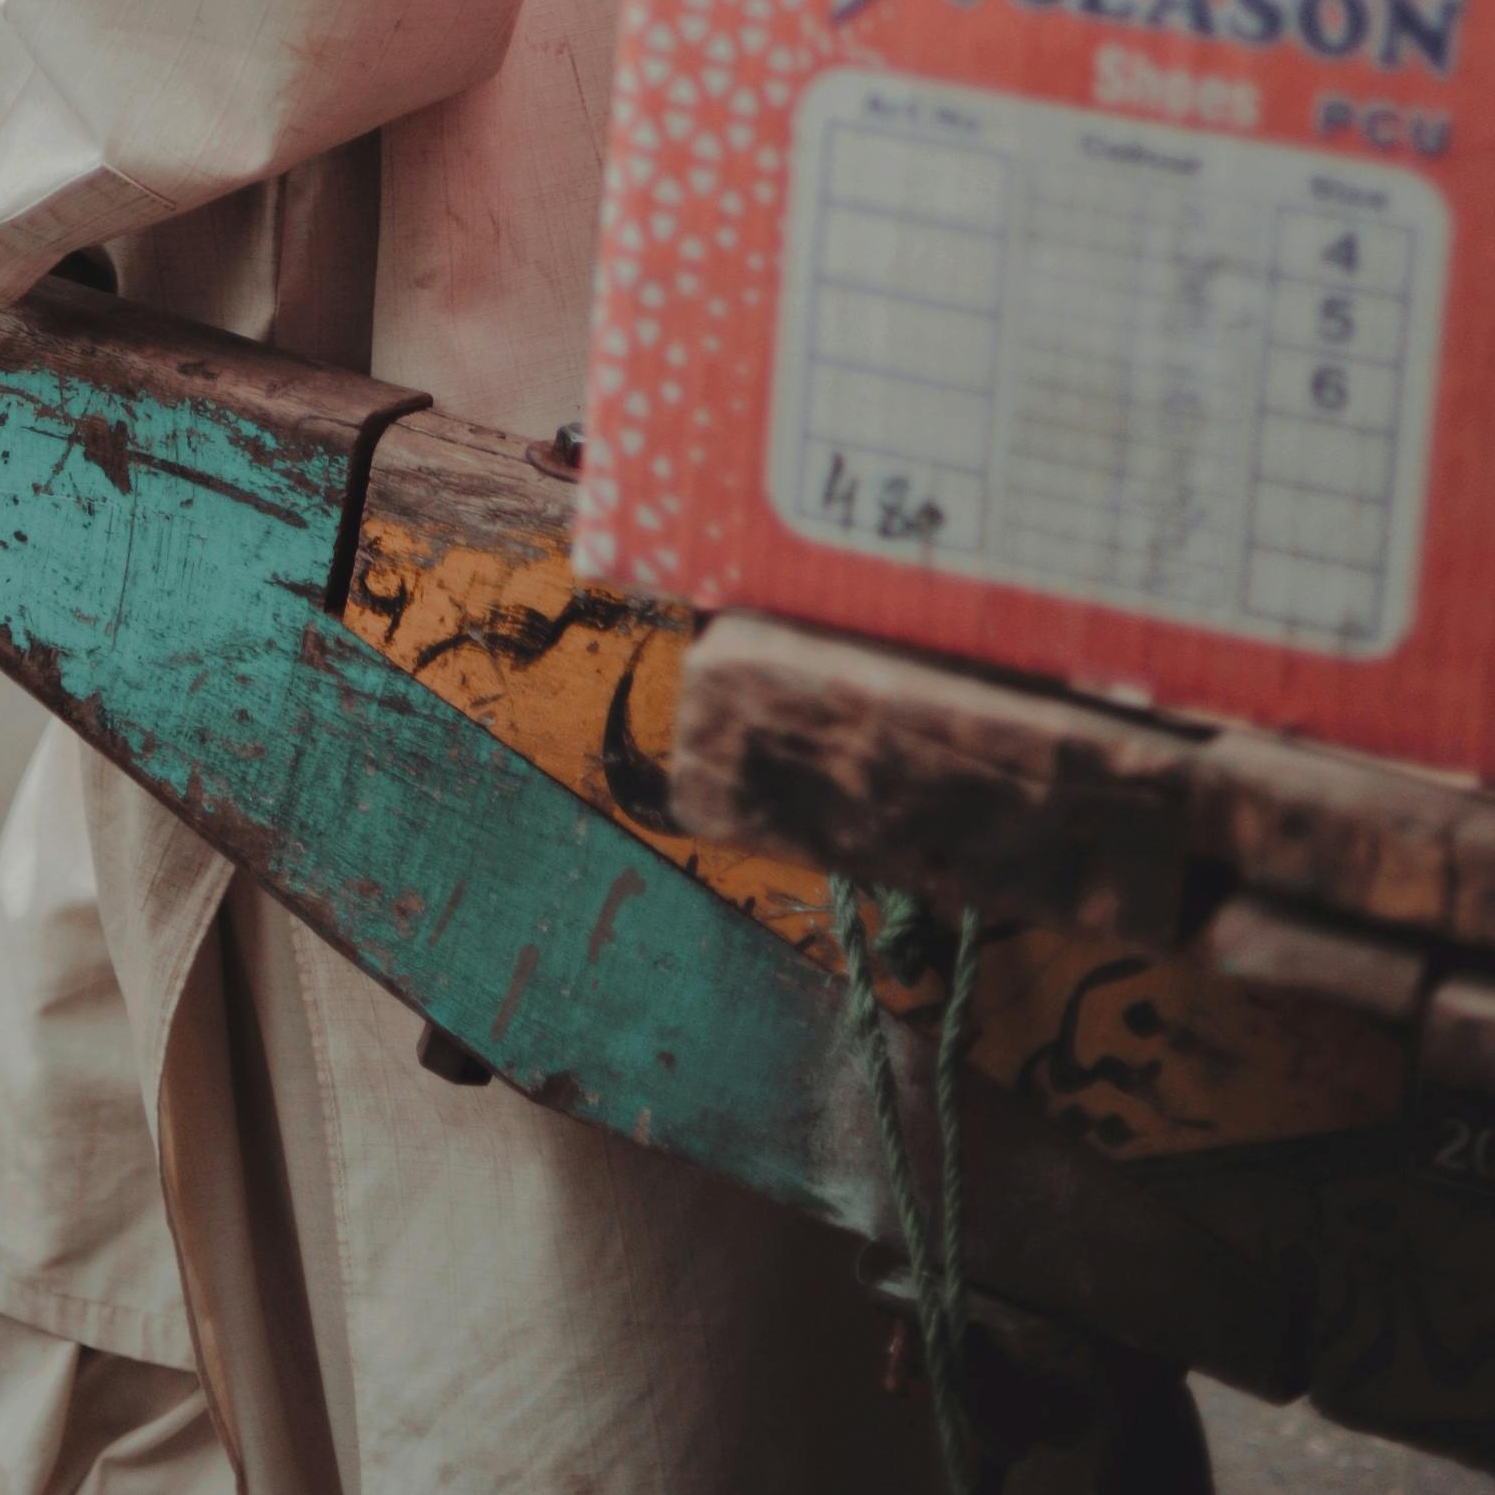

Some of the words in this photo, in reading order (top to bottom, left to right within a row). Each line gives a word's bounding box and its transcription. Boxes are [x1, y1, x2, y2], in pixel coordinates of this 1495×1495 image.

[1092, 43, 1262, 129] Shoes
[1320, 98, 1451, 159] PCU
[1320, 231, 1360, 274] 4
[1318, 295, 1357, 346] 5
[1310, 363, 1351, 413] 6
